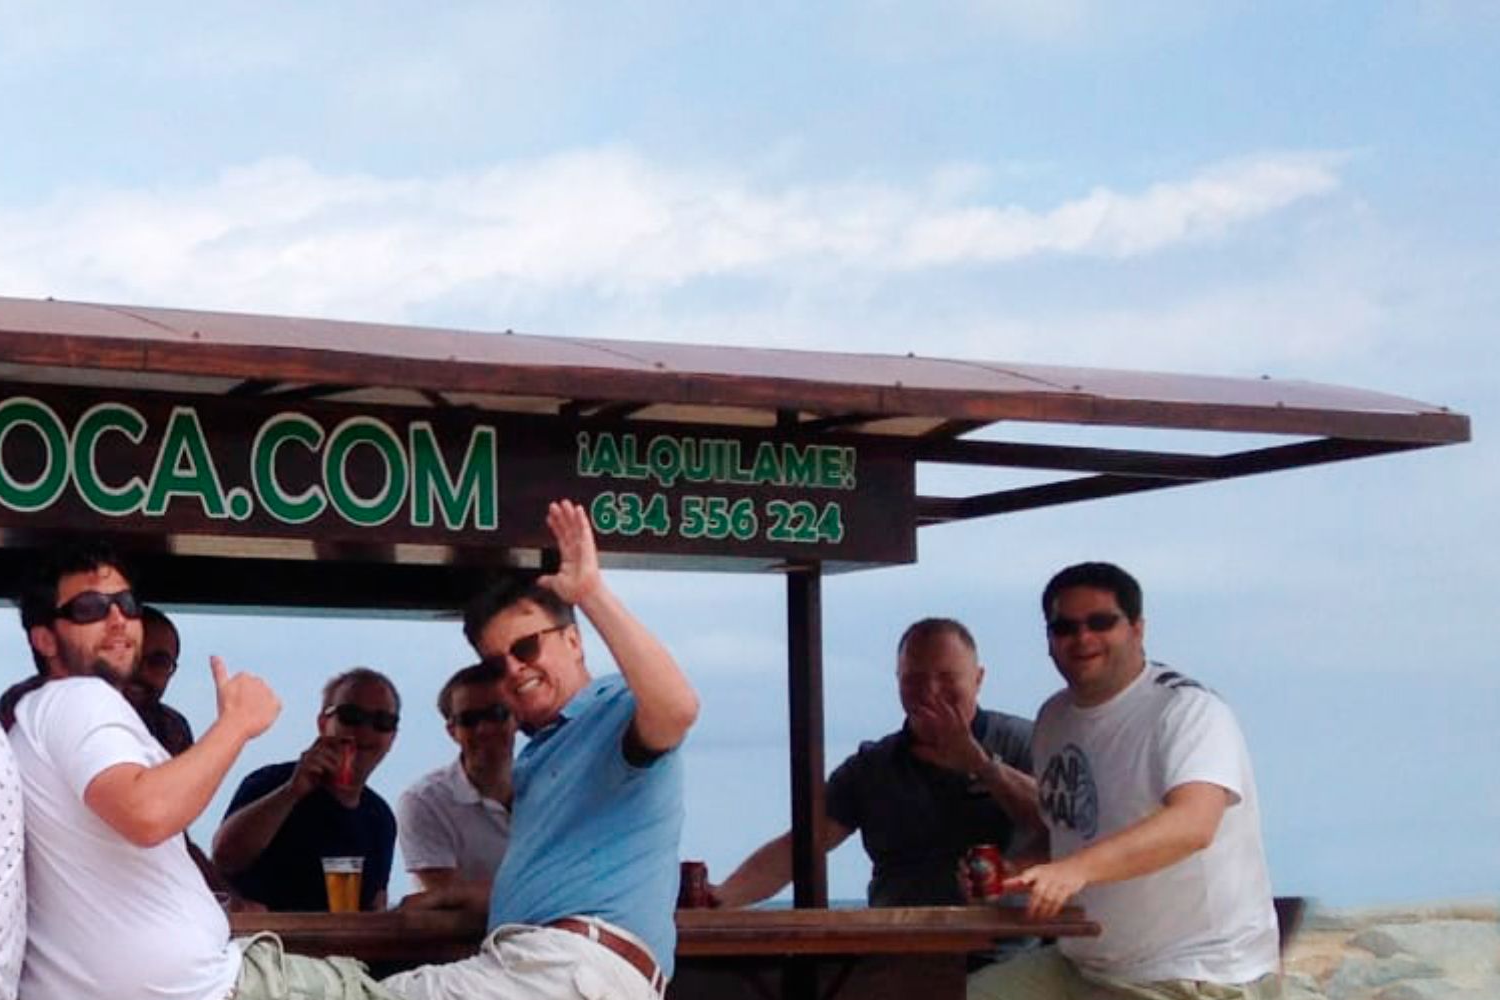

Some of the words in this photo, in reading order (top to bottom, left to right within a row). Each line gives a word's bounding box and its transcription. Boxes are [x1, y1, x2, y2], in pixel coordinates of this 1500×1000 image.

[591, 492, 670, 535] 634
[679, 497, 757, 539] 556
[767, 501, 844, 543] 224
